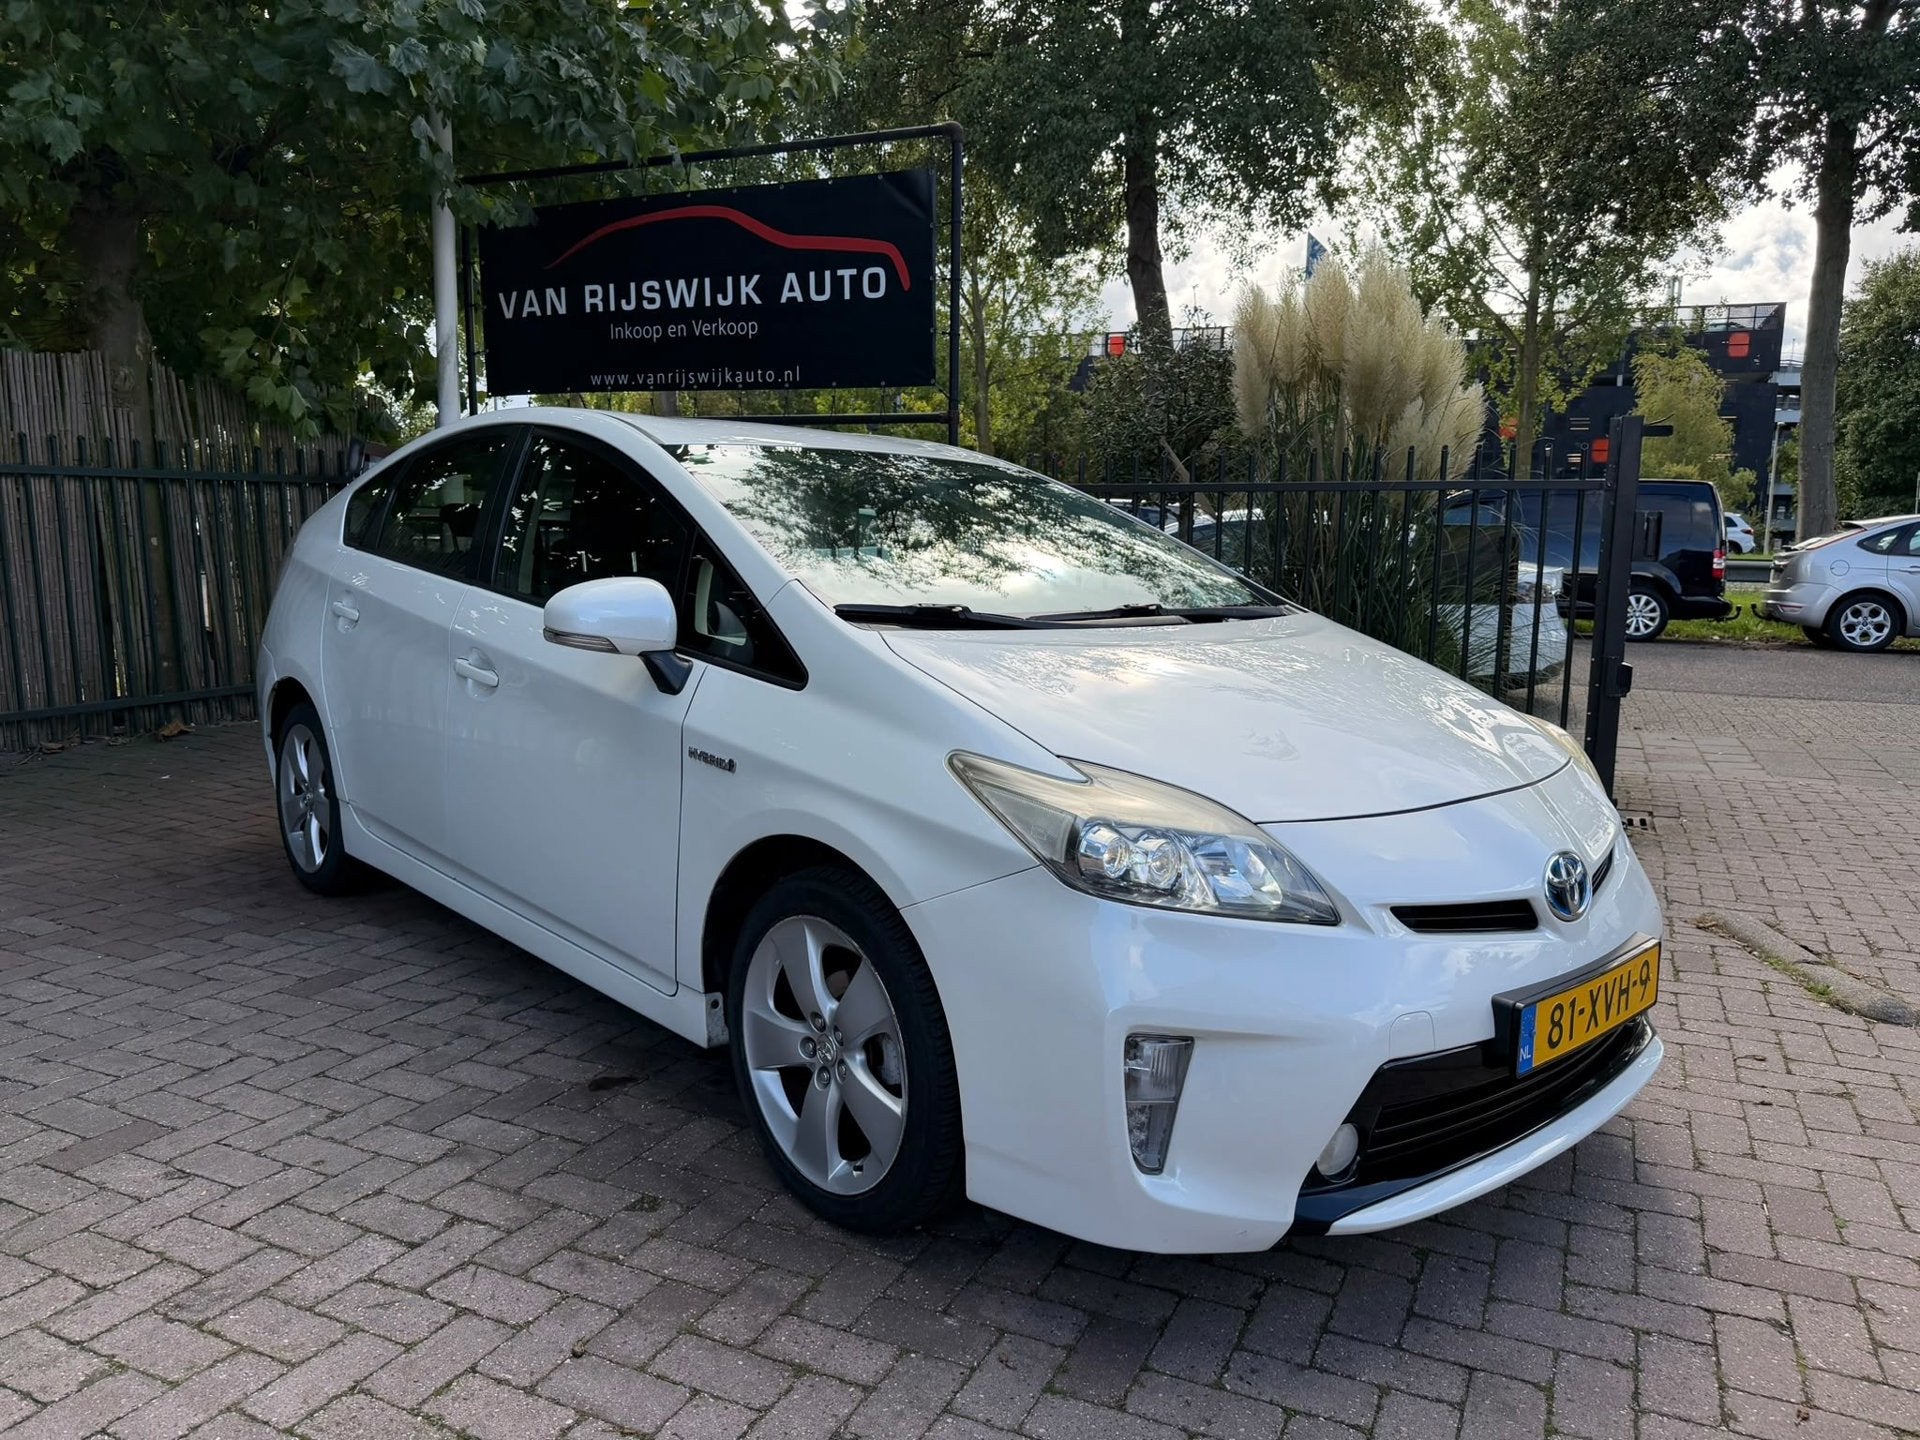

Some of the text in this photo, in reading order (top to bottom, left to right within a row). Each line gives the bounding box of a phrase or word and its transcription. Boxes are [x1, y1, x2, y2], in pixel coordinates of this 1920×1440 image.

[499, 267, 887, 319] VAN RIJSWIJK AUTO
[610, 317, 759, 342] Inkoop en Verkoop
[590, 365, 800, 386] www.vanrijswijkauto.nl
[1547, 959, 1651, 1050] 81-XVH-9
[1519, 1045, 1532, 1063] NL
